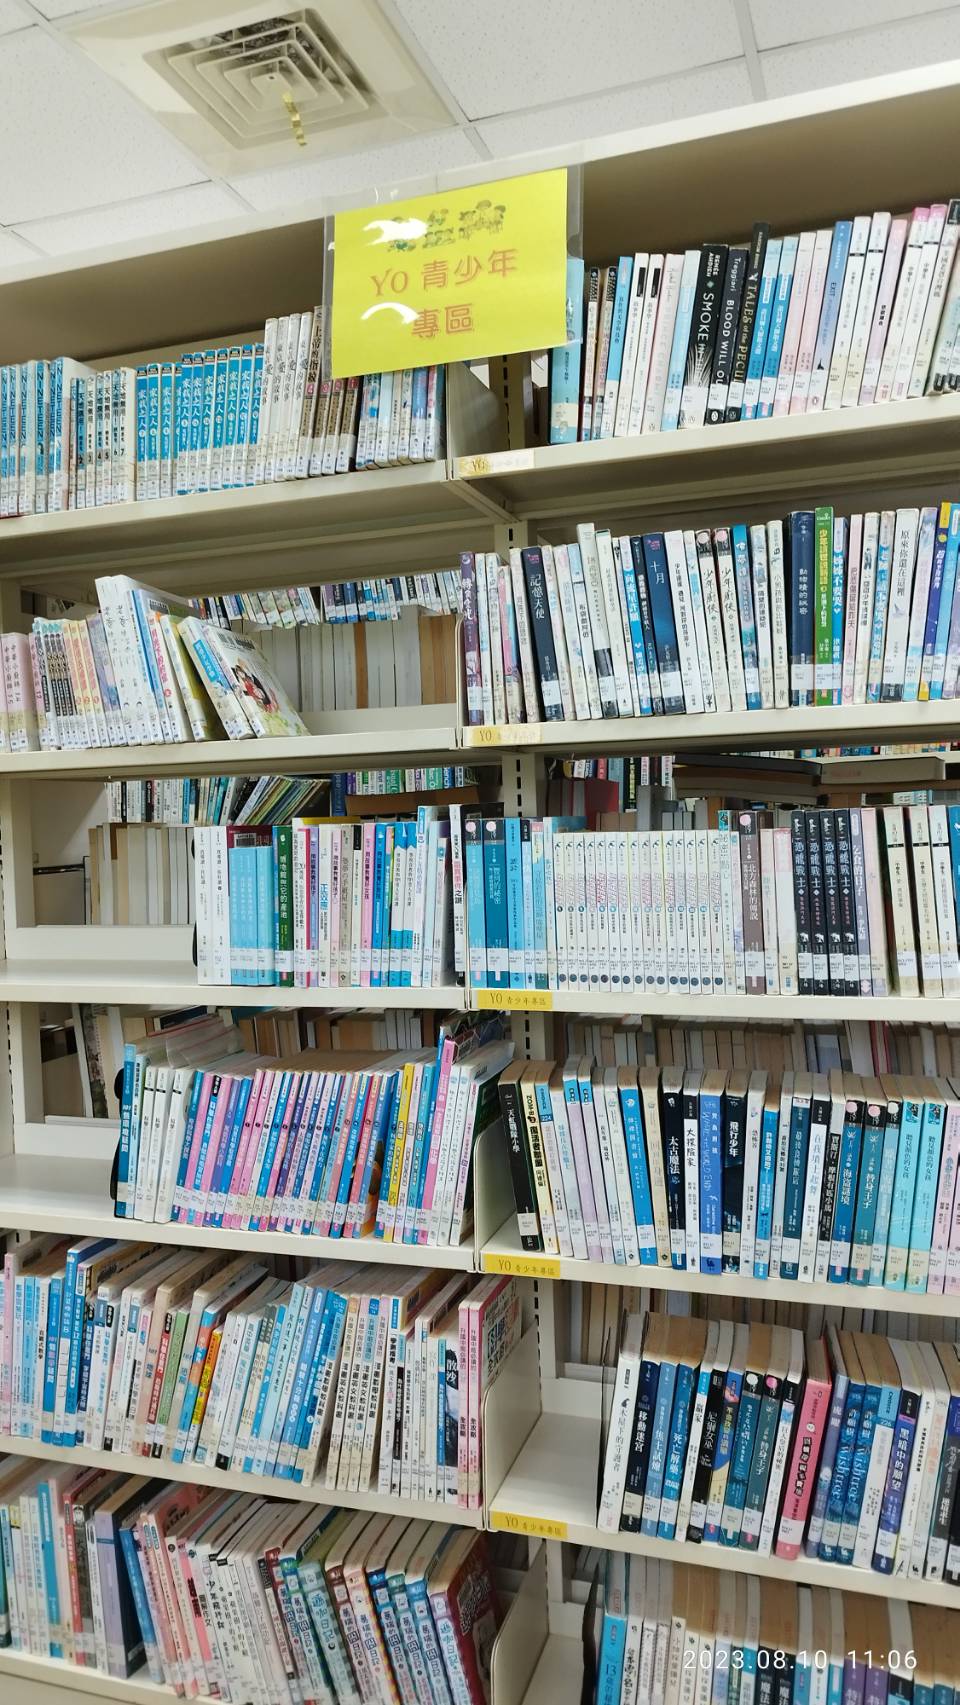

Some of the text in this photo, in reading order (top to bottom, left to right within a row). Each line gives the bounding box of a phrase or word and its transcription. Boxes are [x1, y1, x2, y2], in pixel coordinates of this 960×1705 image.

[370, 248, 518, 296] YO 青少年
[411, 303, 475, 339] 專區
[697, 292, 714, 342] SMOKE
[722, 300, 735, 336] BLOOD
[718, 340, 730, 366] WILL
[650, 560, 666, 584] 十月
[530, 573, 546, 620] 記憶天使
[490, 992, 503, 1005] YO
[668, 1135, 681, 1175] 太古魔法
[728, 1120, 740, 1158] 飛行少年
[498, 1259, 512, 1272] YO
[634, 1410, 648, 1453] 移動迷宮
[504, 1515, 518, 1528] YO
